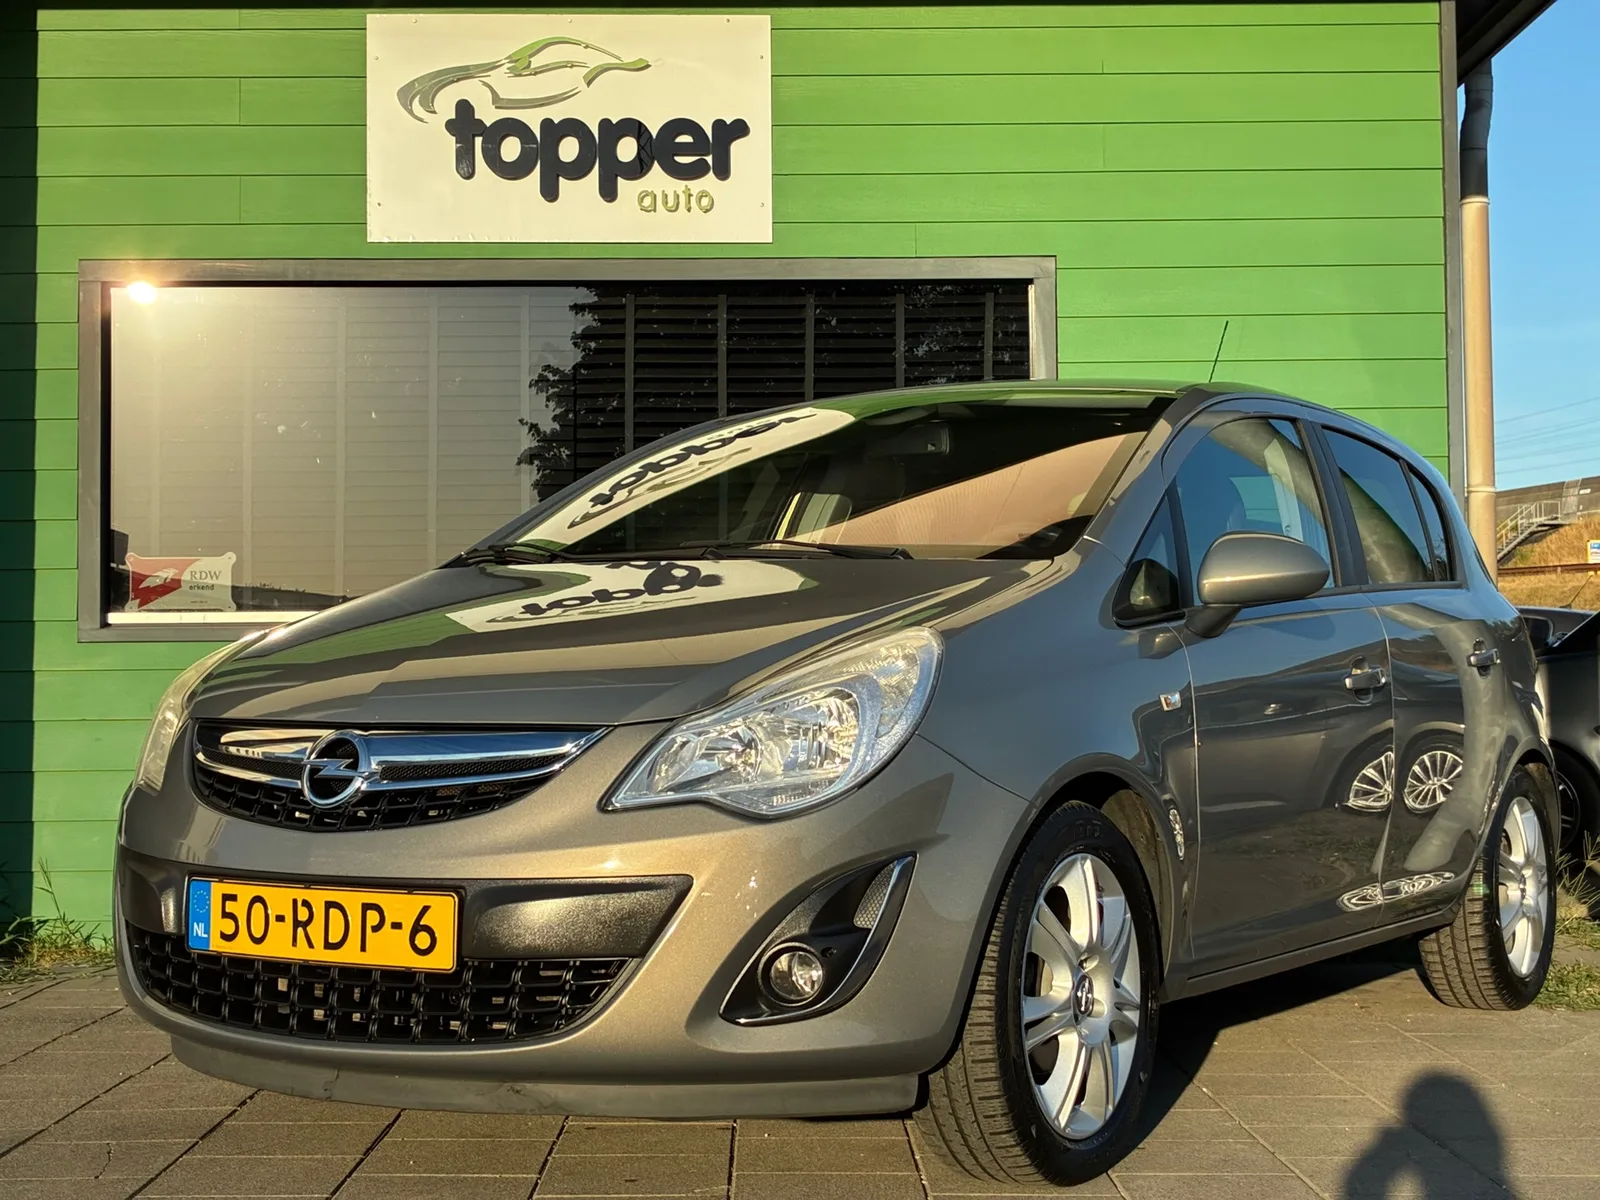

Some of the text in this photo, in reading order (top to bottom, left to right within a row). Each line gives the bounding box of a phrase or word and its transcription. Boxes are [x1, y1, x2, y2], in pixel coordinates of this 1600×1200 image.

[445, 98, 751, 203] topper
[637, 185, 715, 214] auto
[189, 570, 222, 581] RDW
[188, 583, 215, 591] erkend
[193, 922, 208, 938] NL
[219, 892, 438, 957] 50-RDP-6
